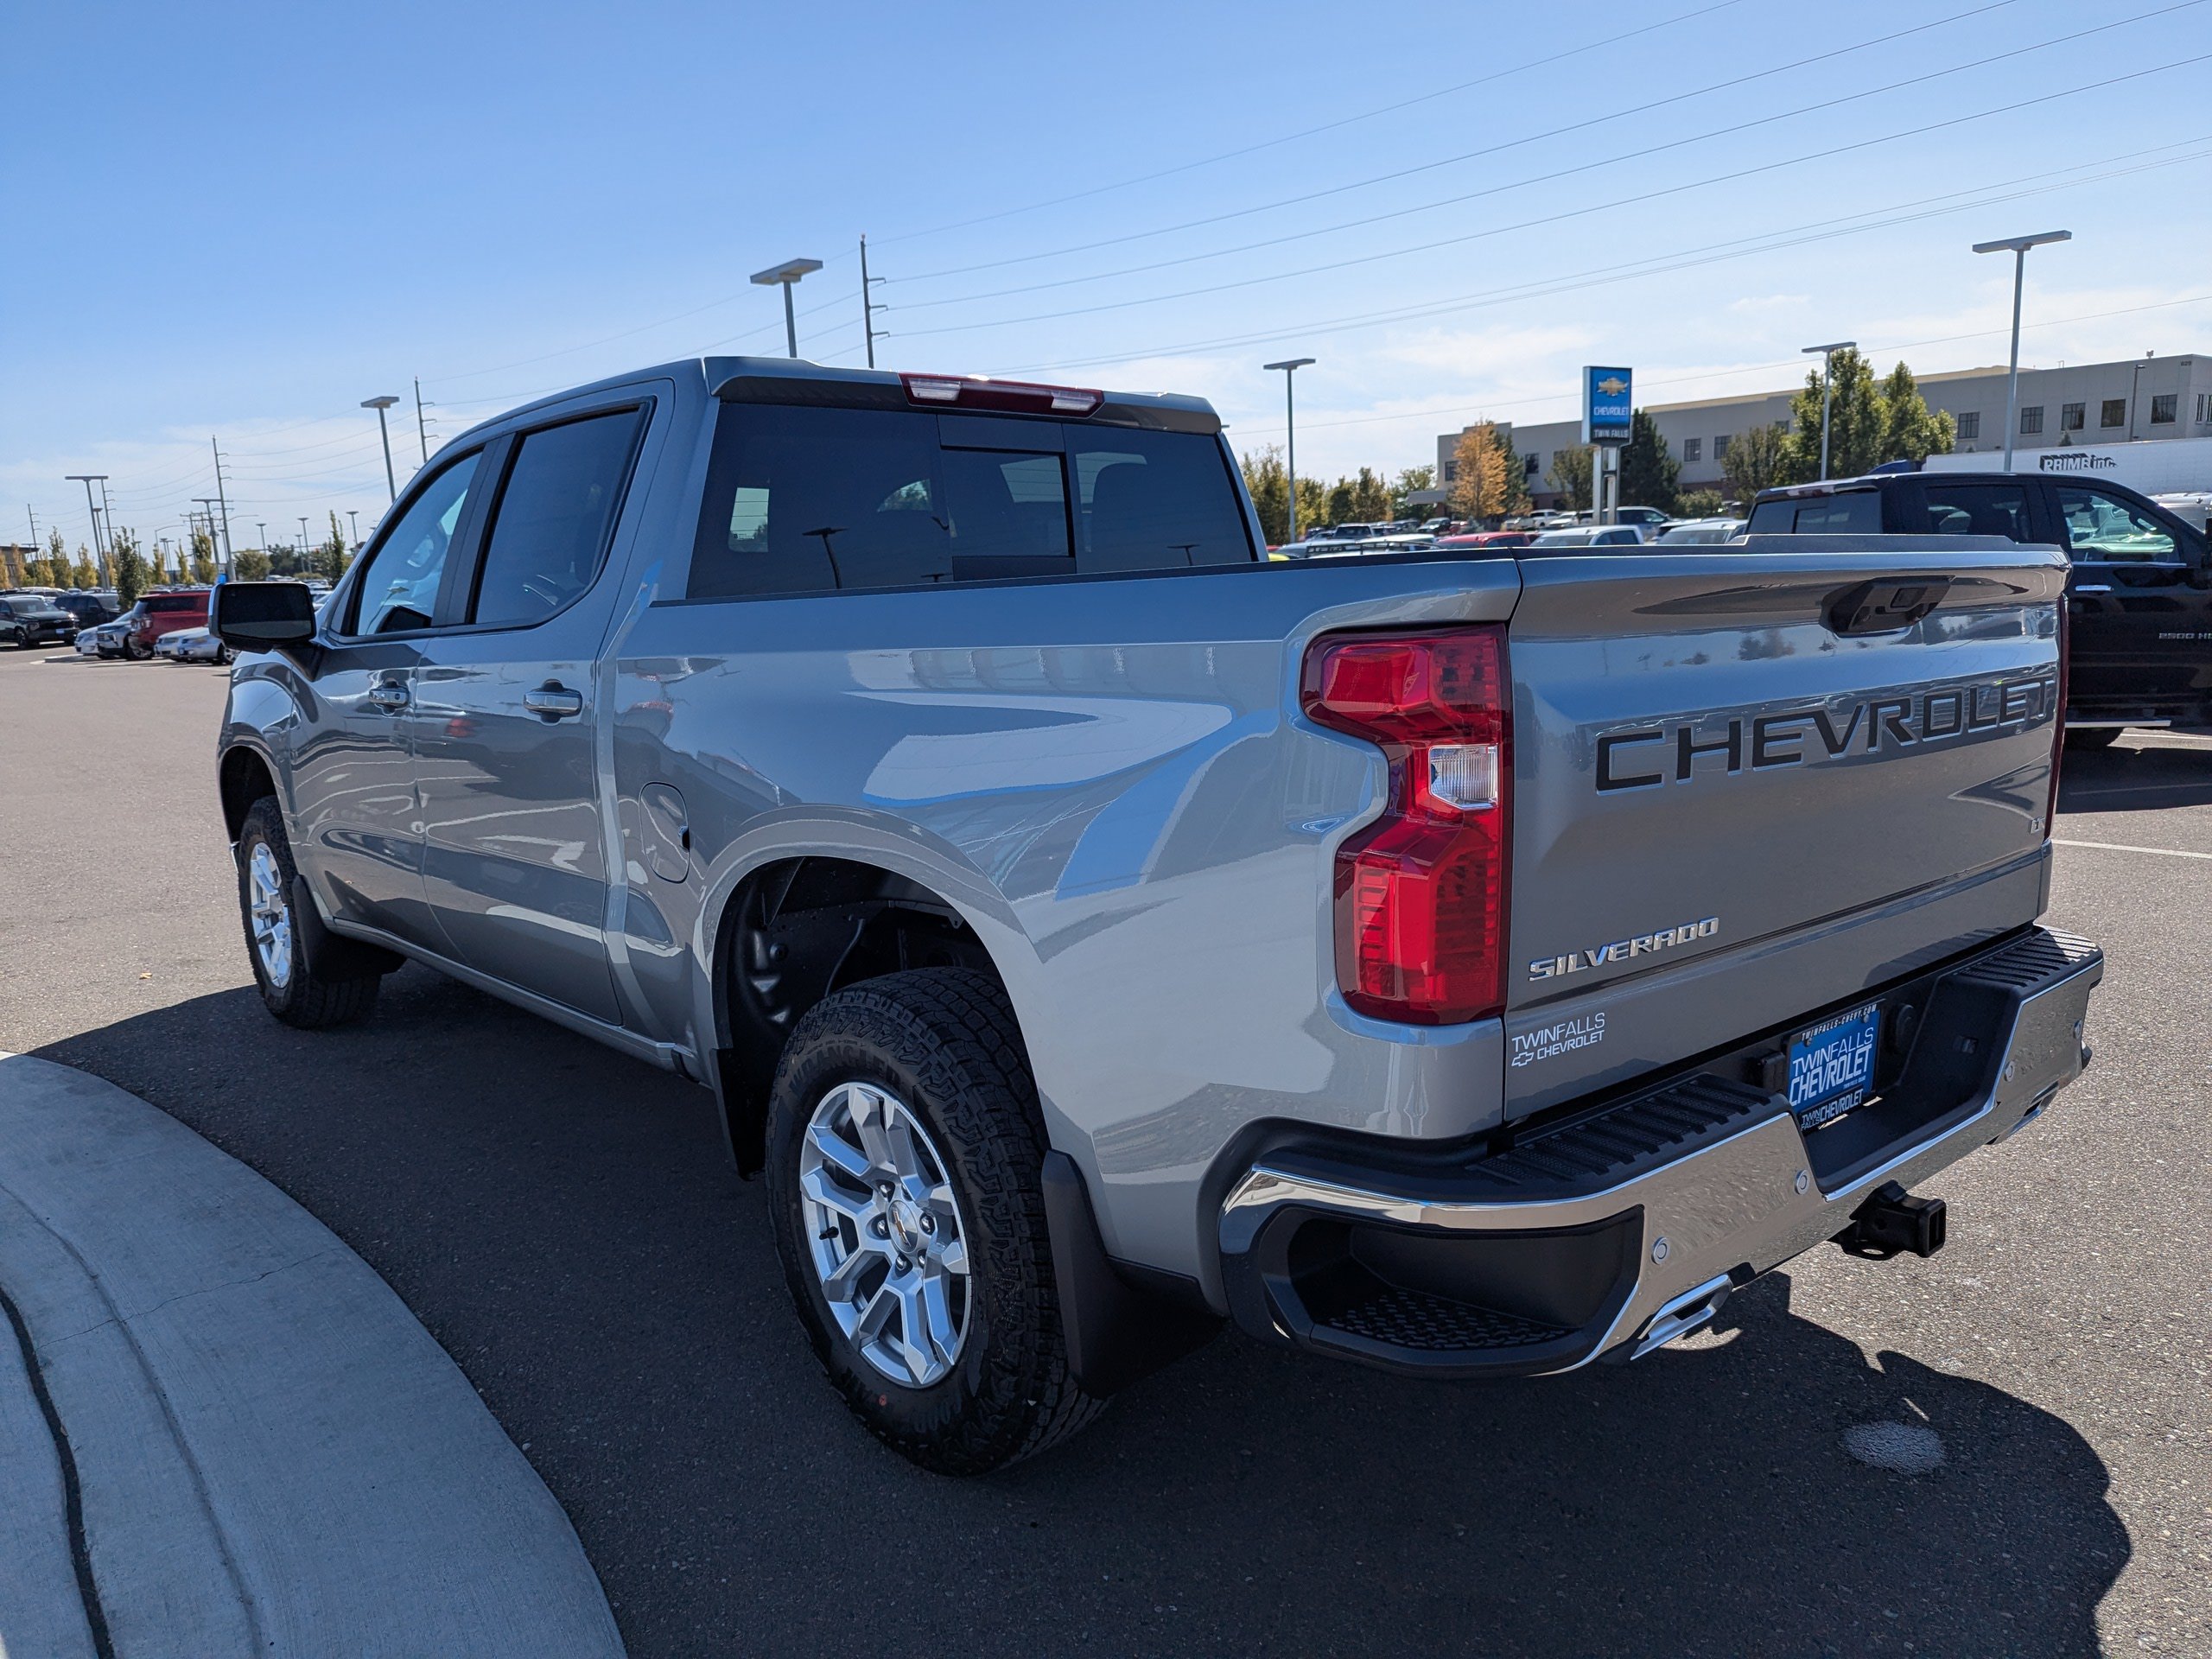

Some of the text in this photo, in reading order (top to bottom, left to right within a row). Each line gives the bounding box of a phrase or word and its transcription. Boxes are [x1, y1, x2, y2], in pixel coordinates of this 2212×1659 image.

[1593, 406, 1629, 416] CHEVROLET
[1593, 429, 1630, 438] TWIN FALLS
[2040, 453, 2089, 473] PRIME
[1596, 677, 2056, 796] CHEVROLET
[1528, 917, 1719, 982] SILVERADO
[1536, 1029, 1605, 1060] CHEVROLET
[789, 1045, 901, 1100] WRANGLER
[1789, 1043, 1872, 1107] CHEVROLET
[1802, 1109, 1821, 1124] TWIN
[1820, 1088, 1864, 1123] CHEVROLET
[1801, 1117, 1821, 1130] FALLS
